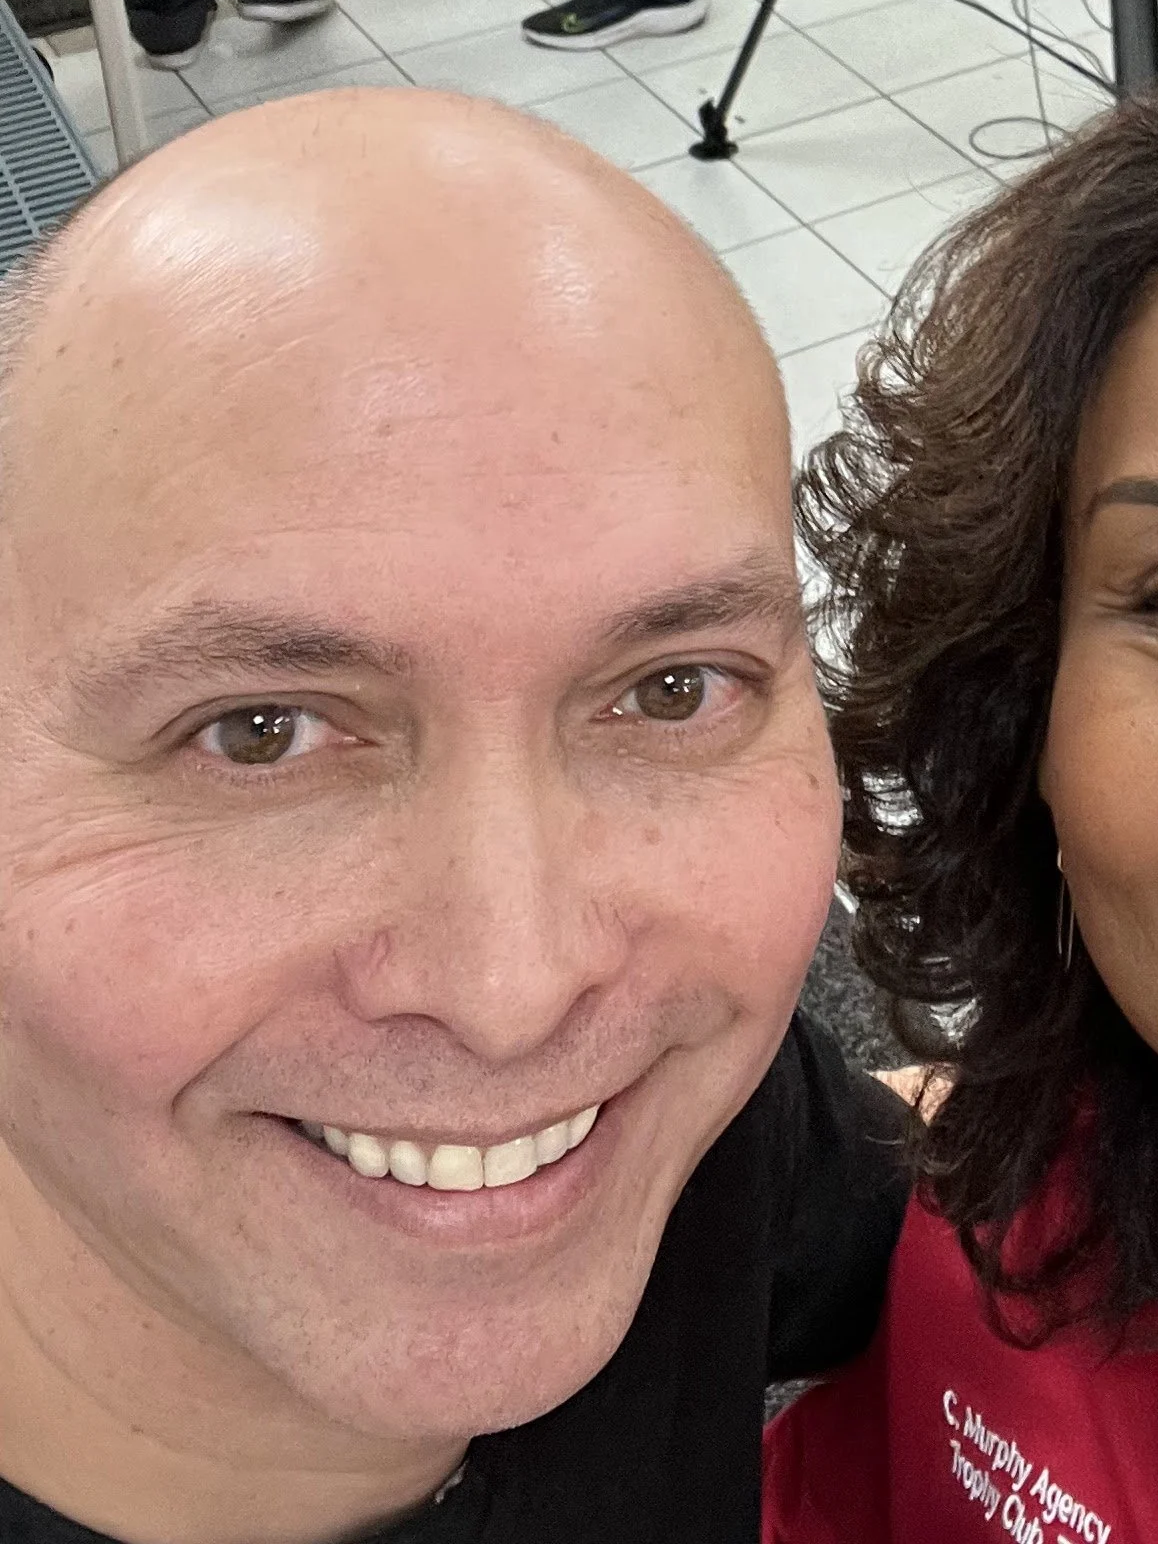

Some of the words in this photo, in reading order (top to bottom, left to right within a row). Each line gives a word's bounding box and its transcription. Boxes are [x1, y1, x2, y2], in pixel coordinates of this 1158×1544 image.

[949, 1438, 1001, 1522] Trophy
[963, 1405, 1033, 1492] Murphy
[1029, 1468, 1112, 1544] Agency
